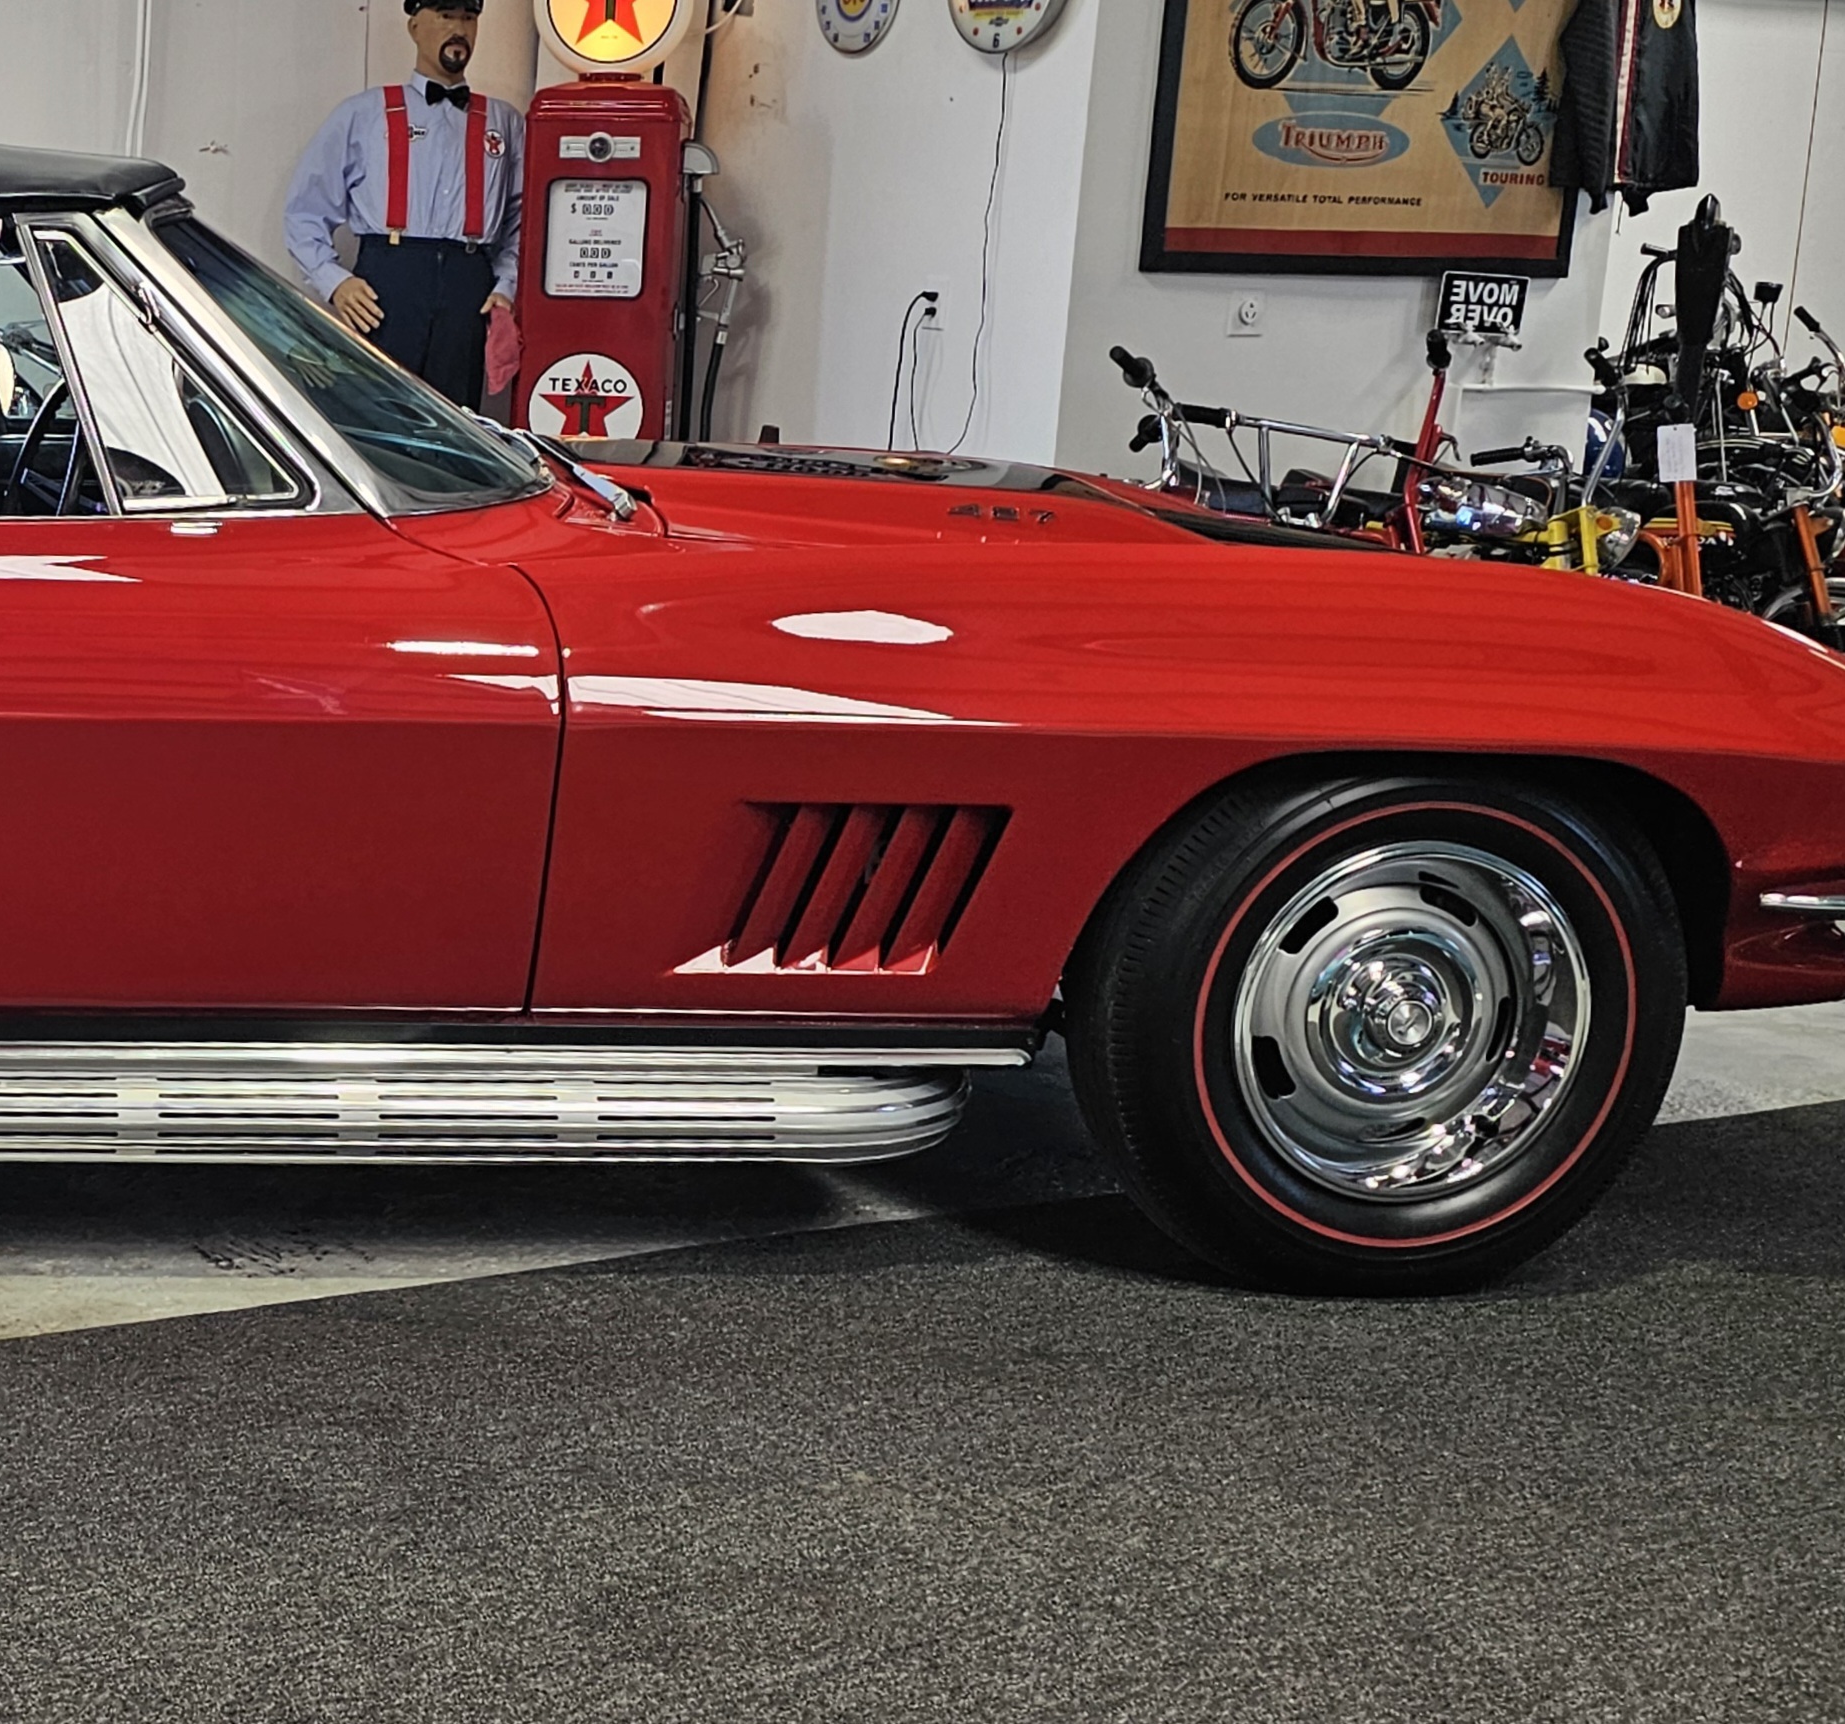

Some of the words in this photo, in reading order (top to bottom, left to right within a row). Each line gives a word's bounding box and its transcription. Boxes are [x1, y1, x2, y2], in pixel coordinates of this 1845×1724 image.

[992, 33, 1000, 48] 6
[1280, 121, 1387, 155] TRIUMPH
[1482, 170, 1545, 186] TOURING
[1224, 192, 1247, 202] FOR
[1252, 193, 1307, 203] VERSATILE
[1312, 195, 1343, 204] TOTAL
[1347, 196, 1422, 206] PERFORMANCE
[548, 377, 628, 394] TEXACO
